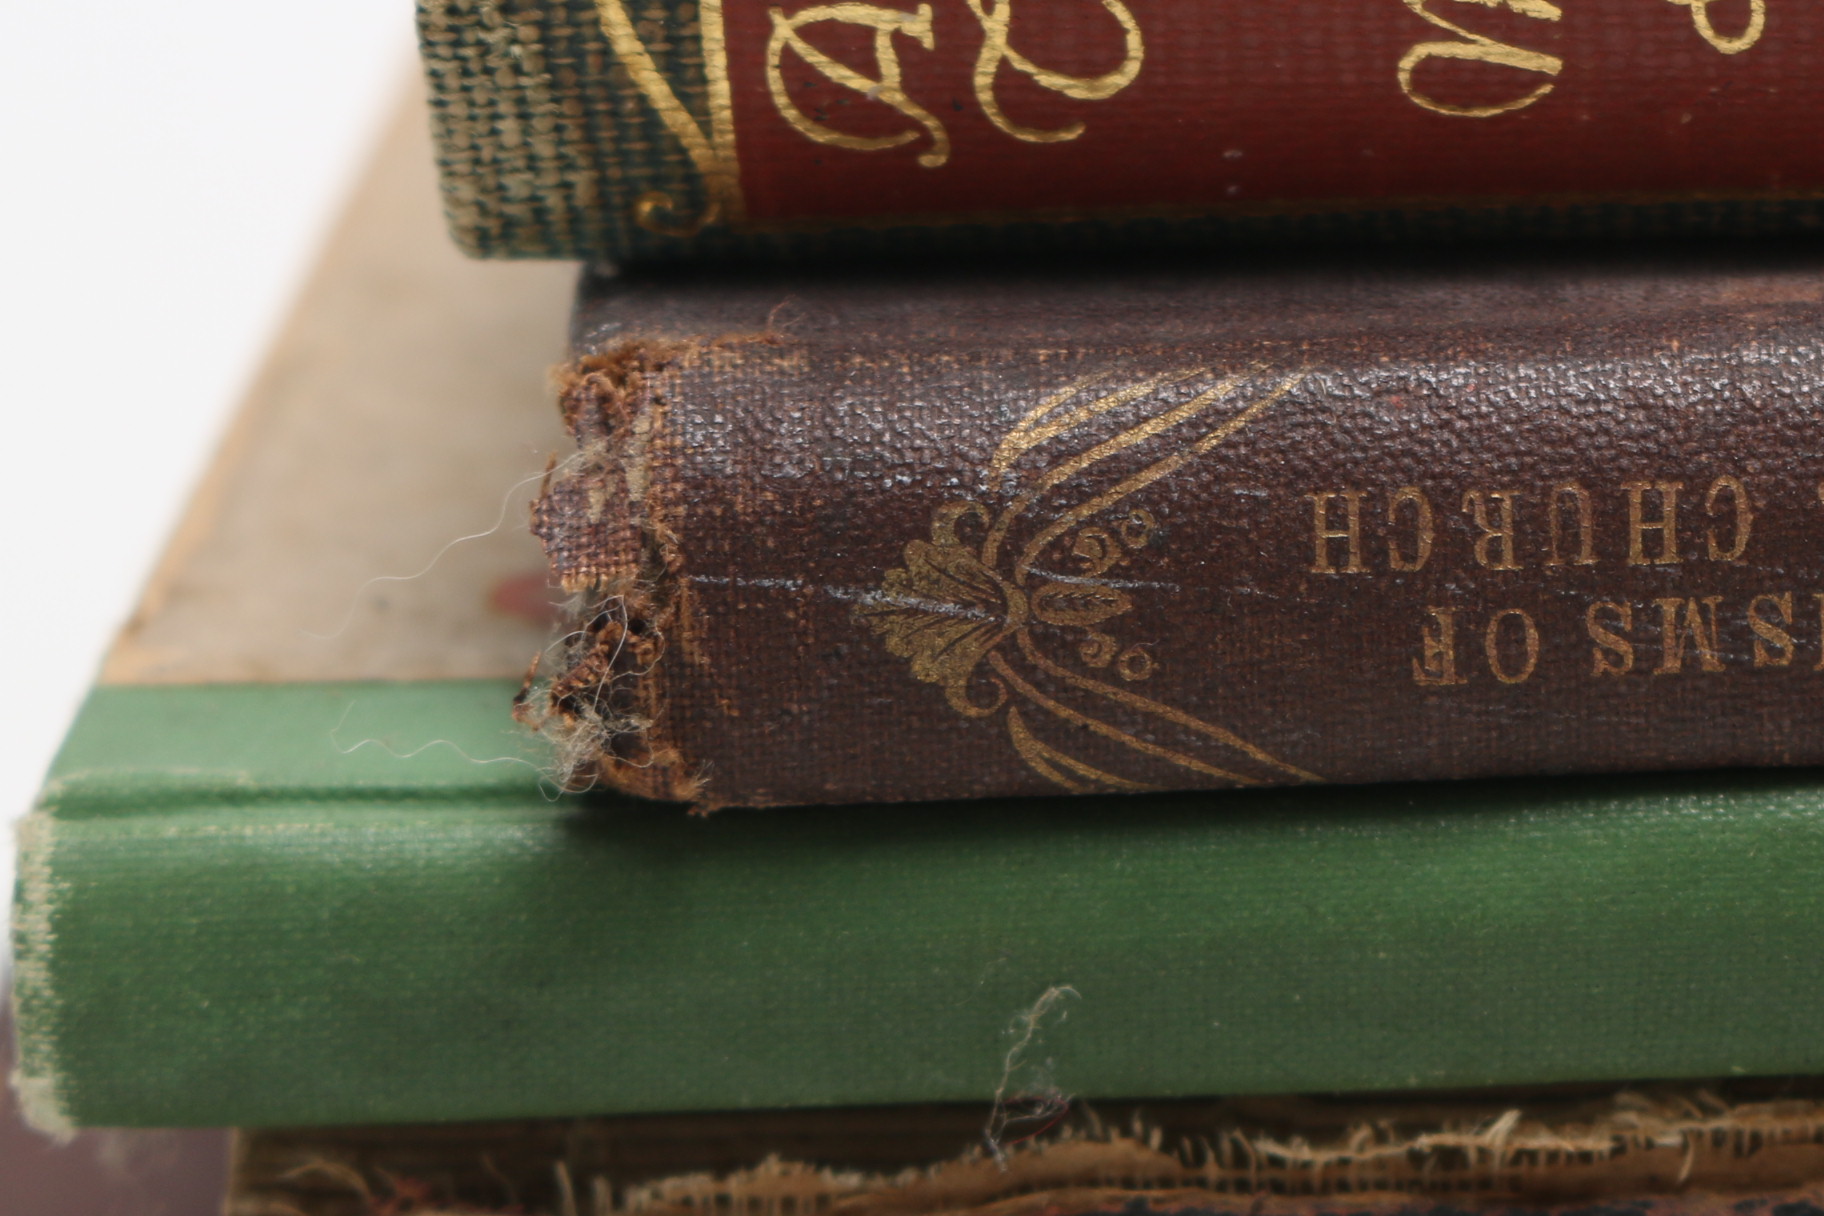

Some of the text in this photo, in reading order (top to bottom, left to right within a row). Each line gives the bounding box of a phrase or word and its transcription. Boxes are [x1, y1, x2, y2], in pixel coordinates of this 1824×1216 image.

[766, 1, 950, 168] A
[1305, 473, 1754, 575] CHURCH
[1411, 605, 1541, 687] OF
